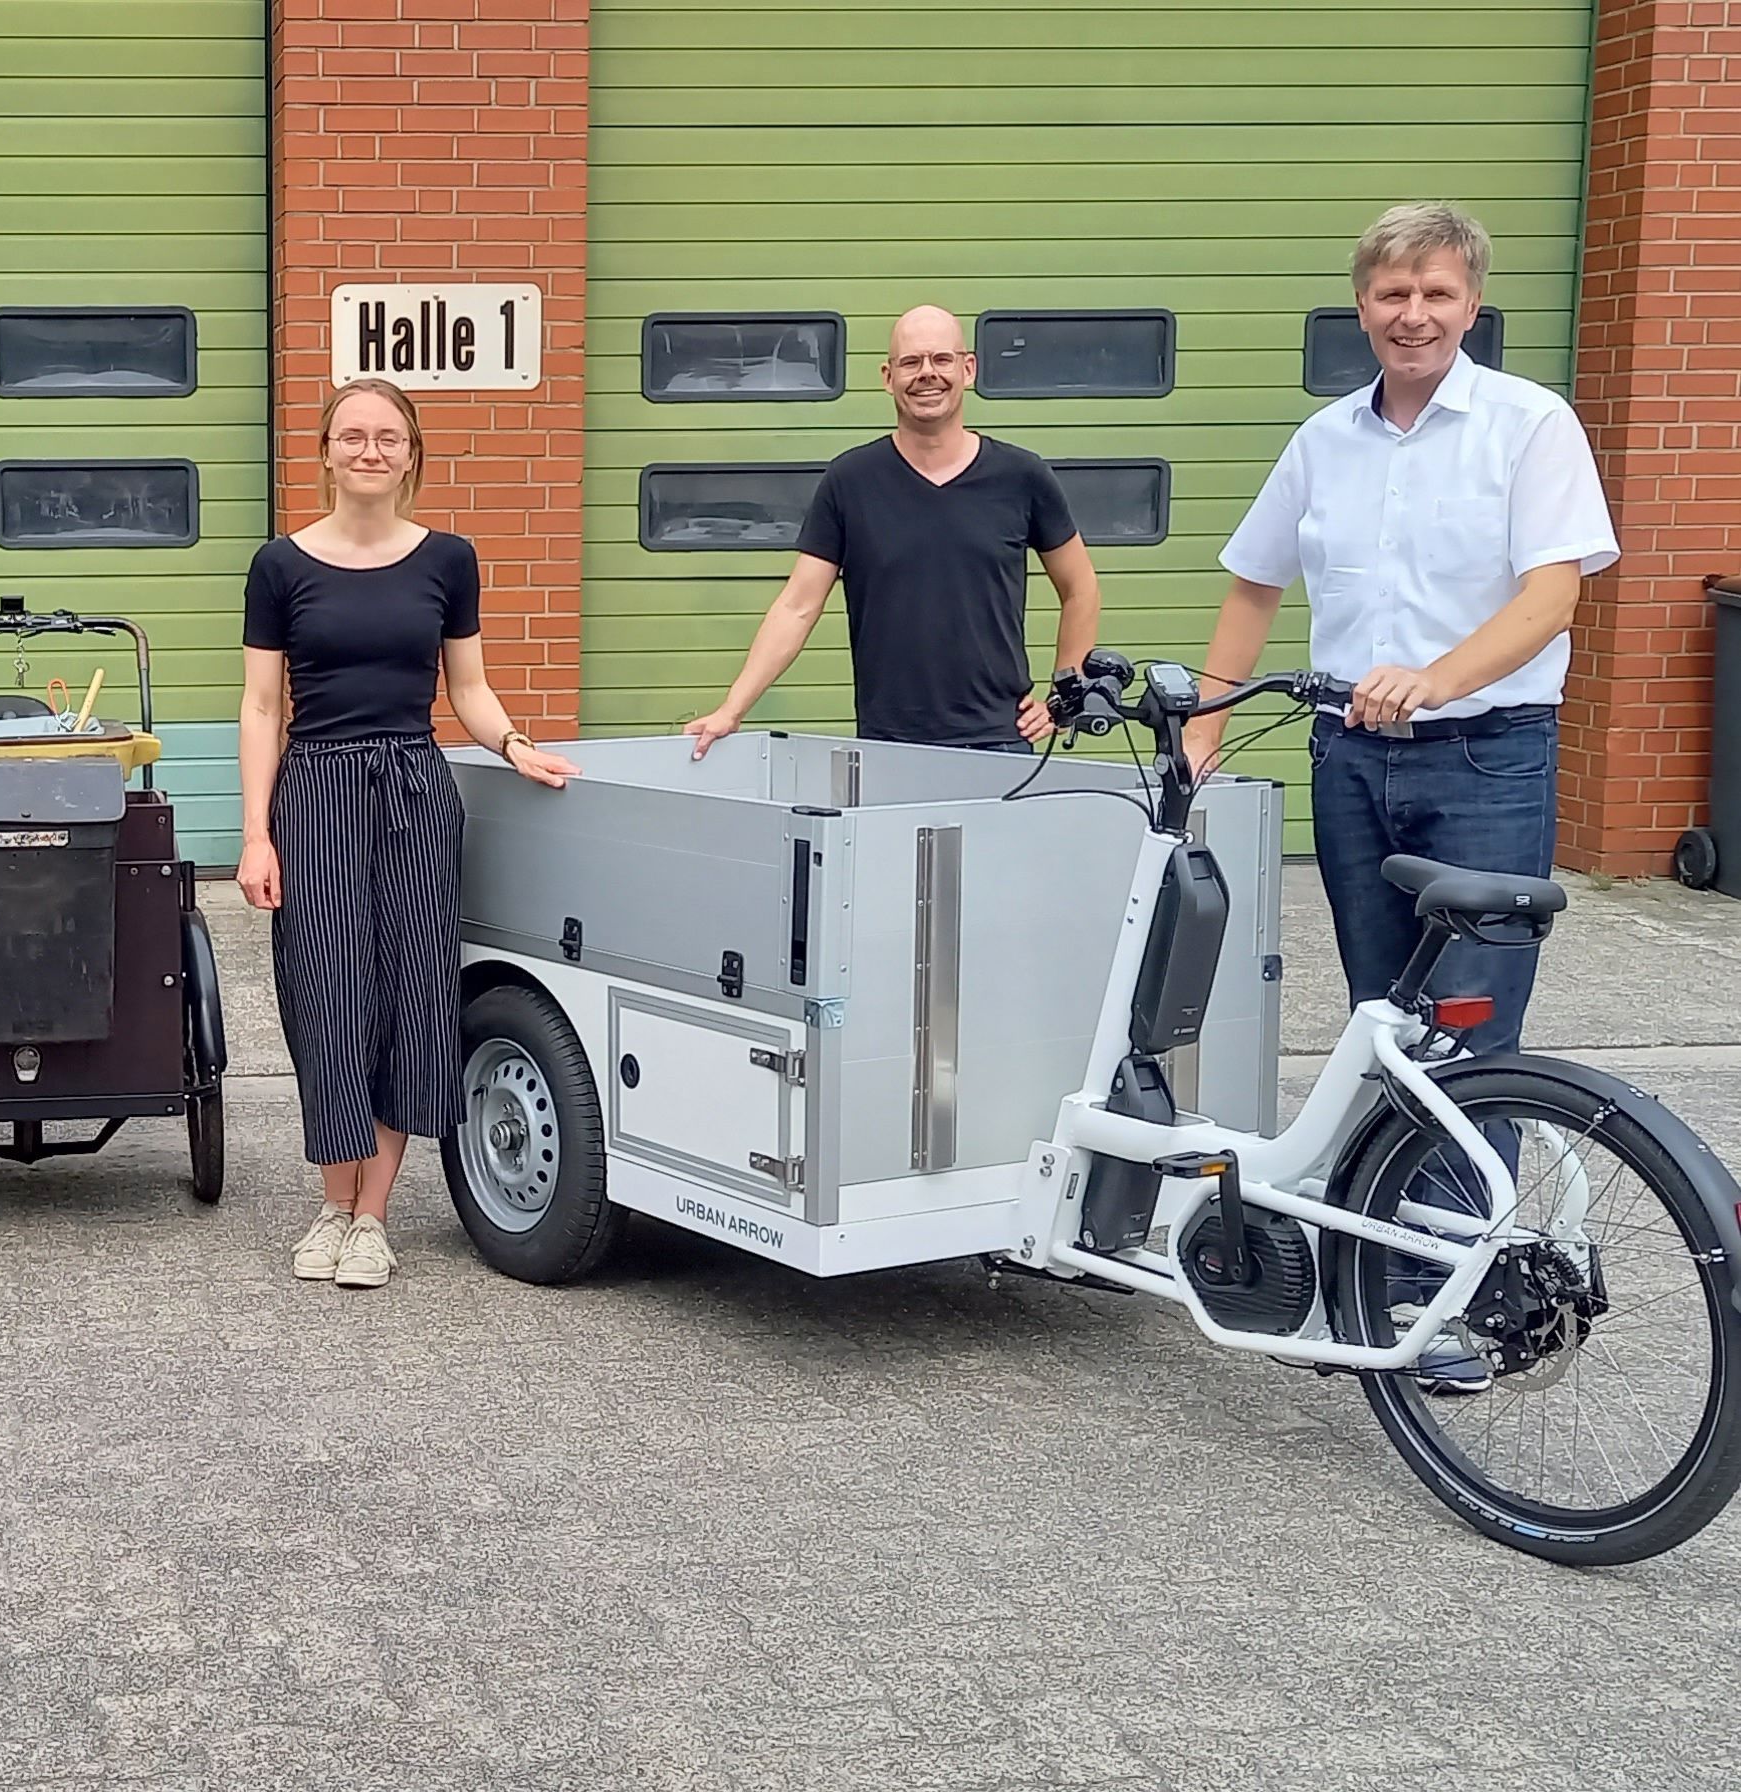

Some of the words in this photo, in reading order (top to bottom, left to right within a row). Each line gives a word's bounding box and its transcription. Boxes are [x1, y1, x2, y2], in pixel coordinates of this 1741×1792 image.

[359, 300, 475, 372] Halle
[500, 300, 515, 370] 1
[676, 1195, 725, 1229] URBAN
[728, 1215, 784, 1249] ARROW
[1361, 1219, 1399, 1237] URBAN
[1400, 1232, 1440, 1250] ARROW
